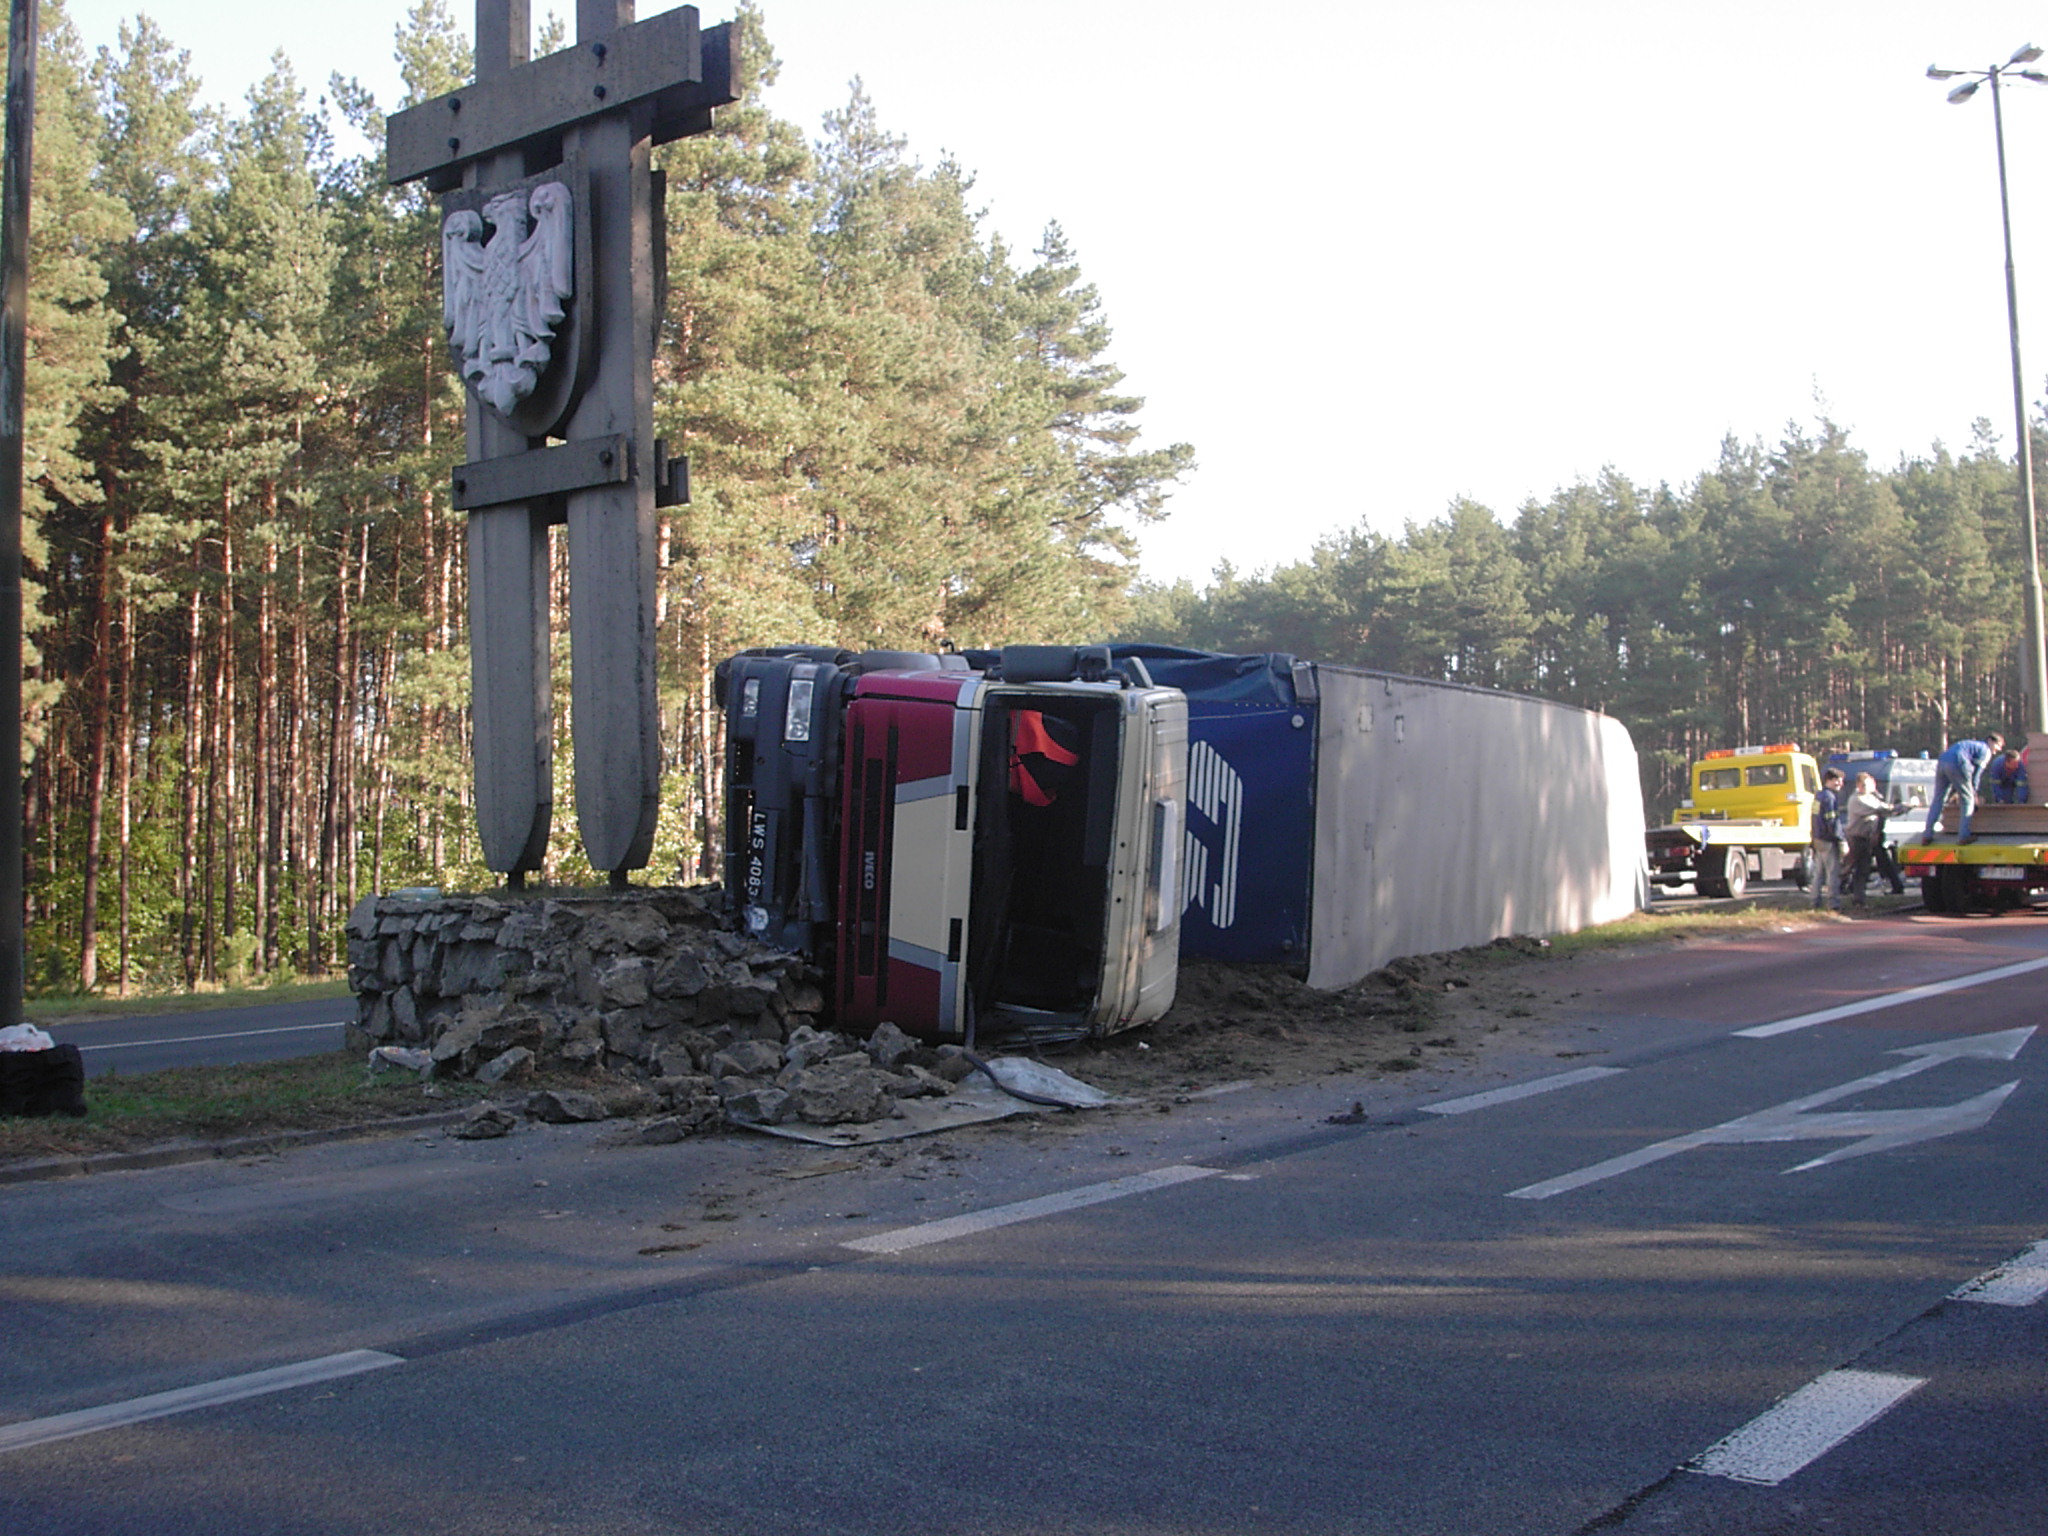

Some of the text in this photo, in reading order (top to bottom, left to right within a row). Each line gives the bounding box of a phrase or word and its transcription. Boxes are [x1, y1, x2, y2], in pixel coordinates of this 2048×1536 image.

[748, 813, 766, 896] LWS 4083
[864, 851, 875, 889] IVECO
